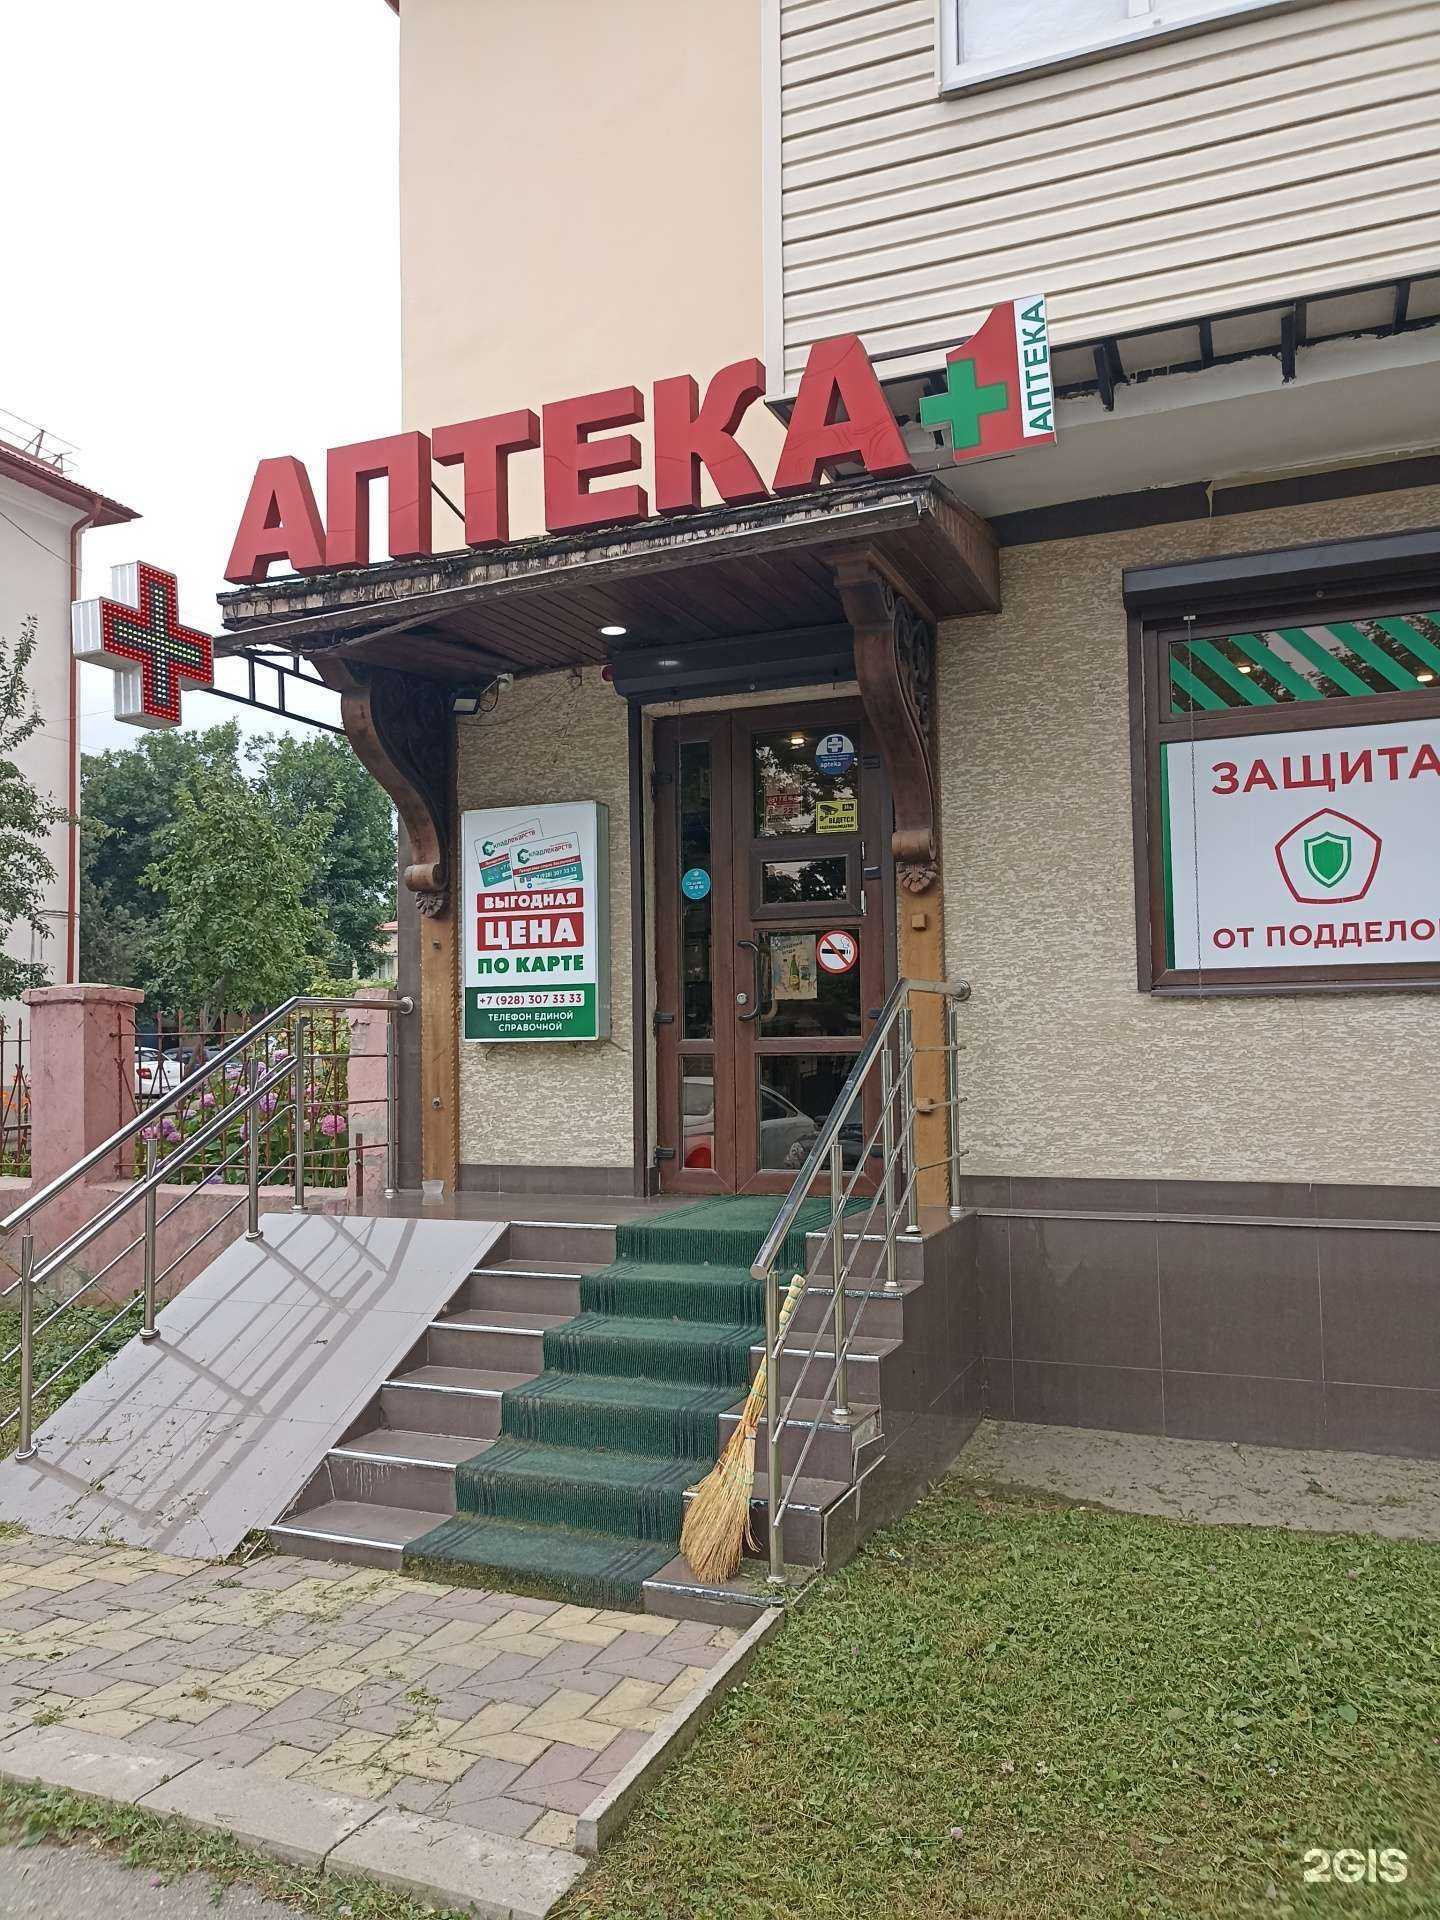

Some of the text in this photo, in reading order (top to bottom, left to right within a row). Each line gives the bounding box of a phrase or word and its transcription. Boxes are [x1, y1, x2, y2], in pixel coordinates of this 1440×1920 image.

[1020, 299, 1053, 432] АПТЕКА
[223, 333, 916, 584] АПТЕКА
[1211, 744, 1440, 795] ЗАЩИТА
[484, 892, 577, 909] ВЫГОДНАЯ
[485, 918, 577, 950] ЦЕНА
[1213, 918, 1440, 949] ОТ ПОДДЕЛО
[478, 954, 584, 974] ПО КАРТЕ
[480, 993, 582, 1006] +7 (928) 307 33 33
[488, 1010, 574, 1022] ТЕЛЕФОН ЕДИНОЙ
[498, 1022, 562, 1032] СПРАВОЧНОЙ
